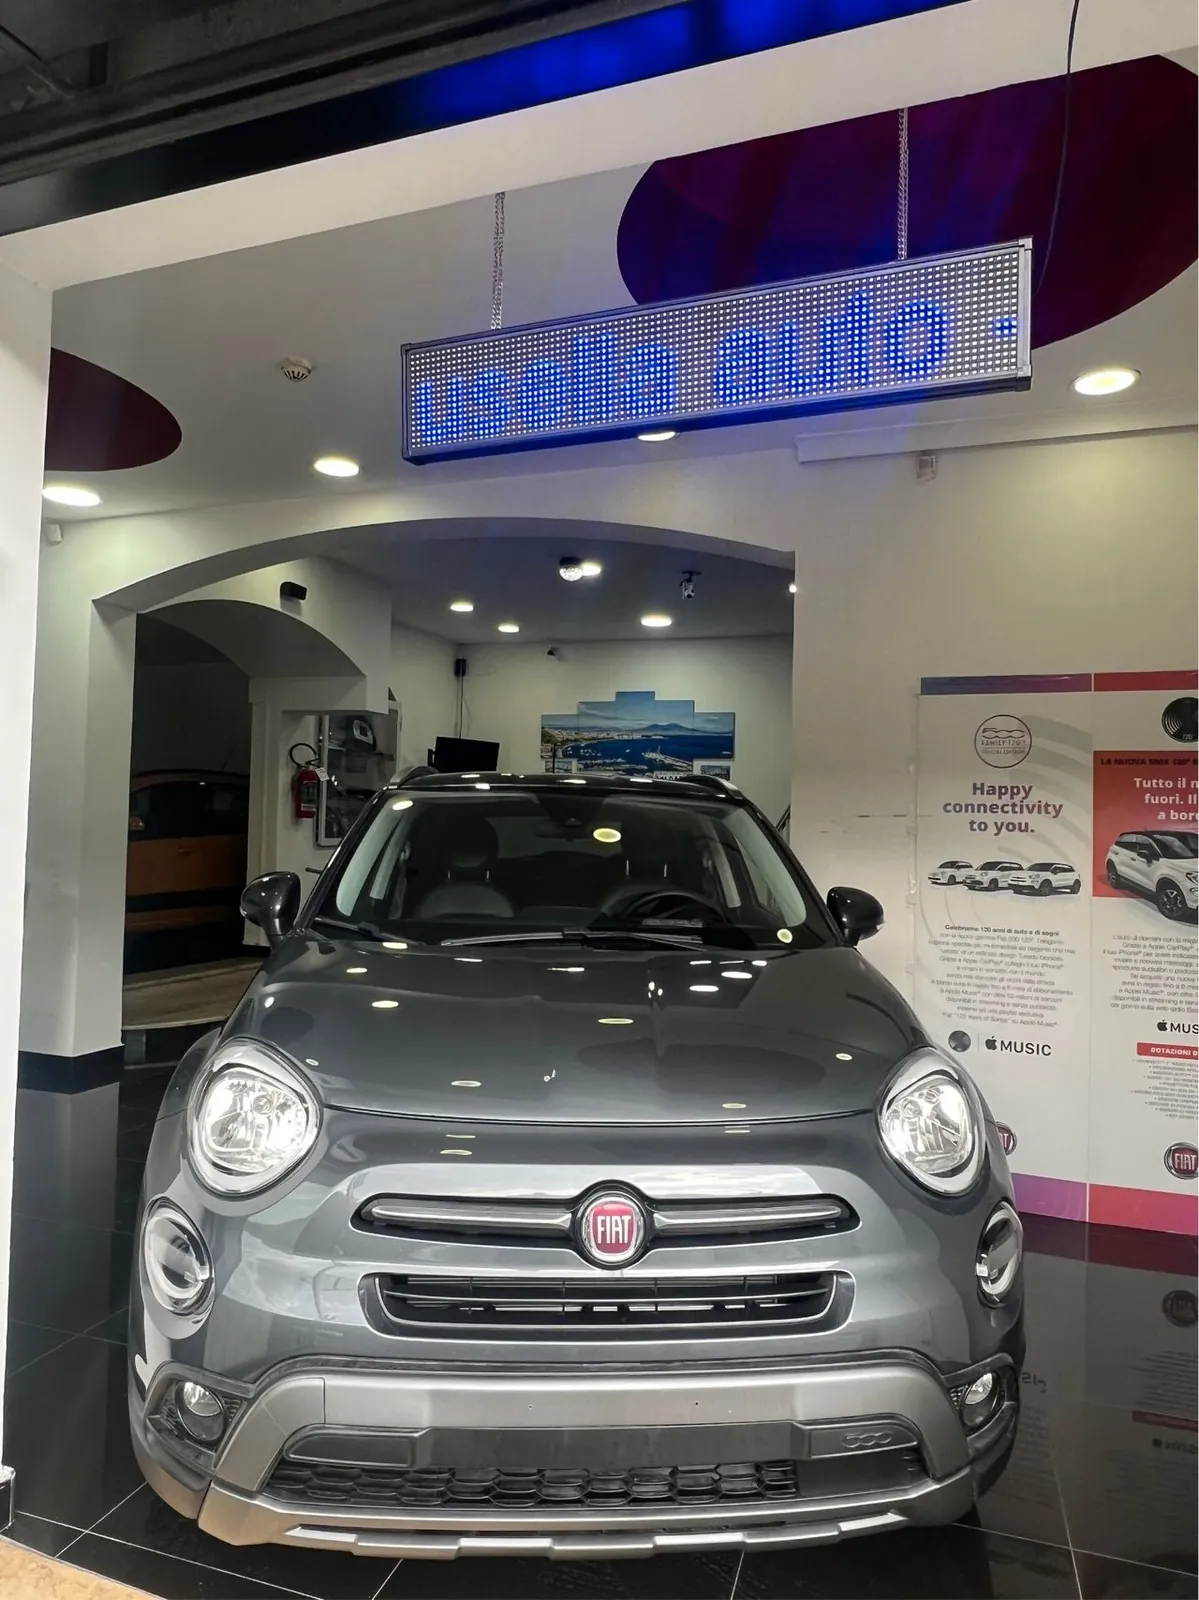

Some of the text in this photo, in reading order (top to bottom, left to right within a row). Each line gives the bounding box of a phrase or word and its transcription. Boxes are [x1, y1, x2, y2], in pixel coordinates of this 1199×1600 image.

[716, 289, 947, 401] auto
[972, 782, 1033, 800] Happy
[1134, 777, 1174, 789] Tutto
[1177, 777, 1187, 789] il
[1144, 793, 1184, 805] fuori.
[942, 800, 1064, 819] connectivity
[1157, 811, 1167, 820] a
[968, 819, 1035, 836] to you.
[1000, 1039, 1052, 1056] MUSIC
[1150, 1047, 1191, 1056] DOTAZIONI
[1174, 1153, 1197, 1171] FIAT
[597, 1215, 631, 1244] FIAT
